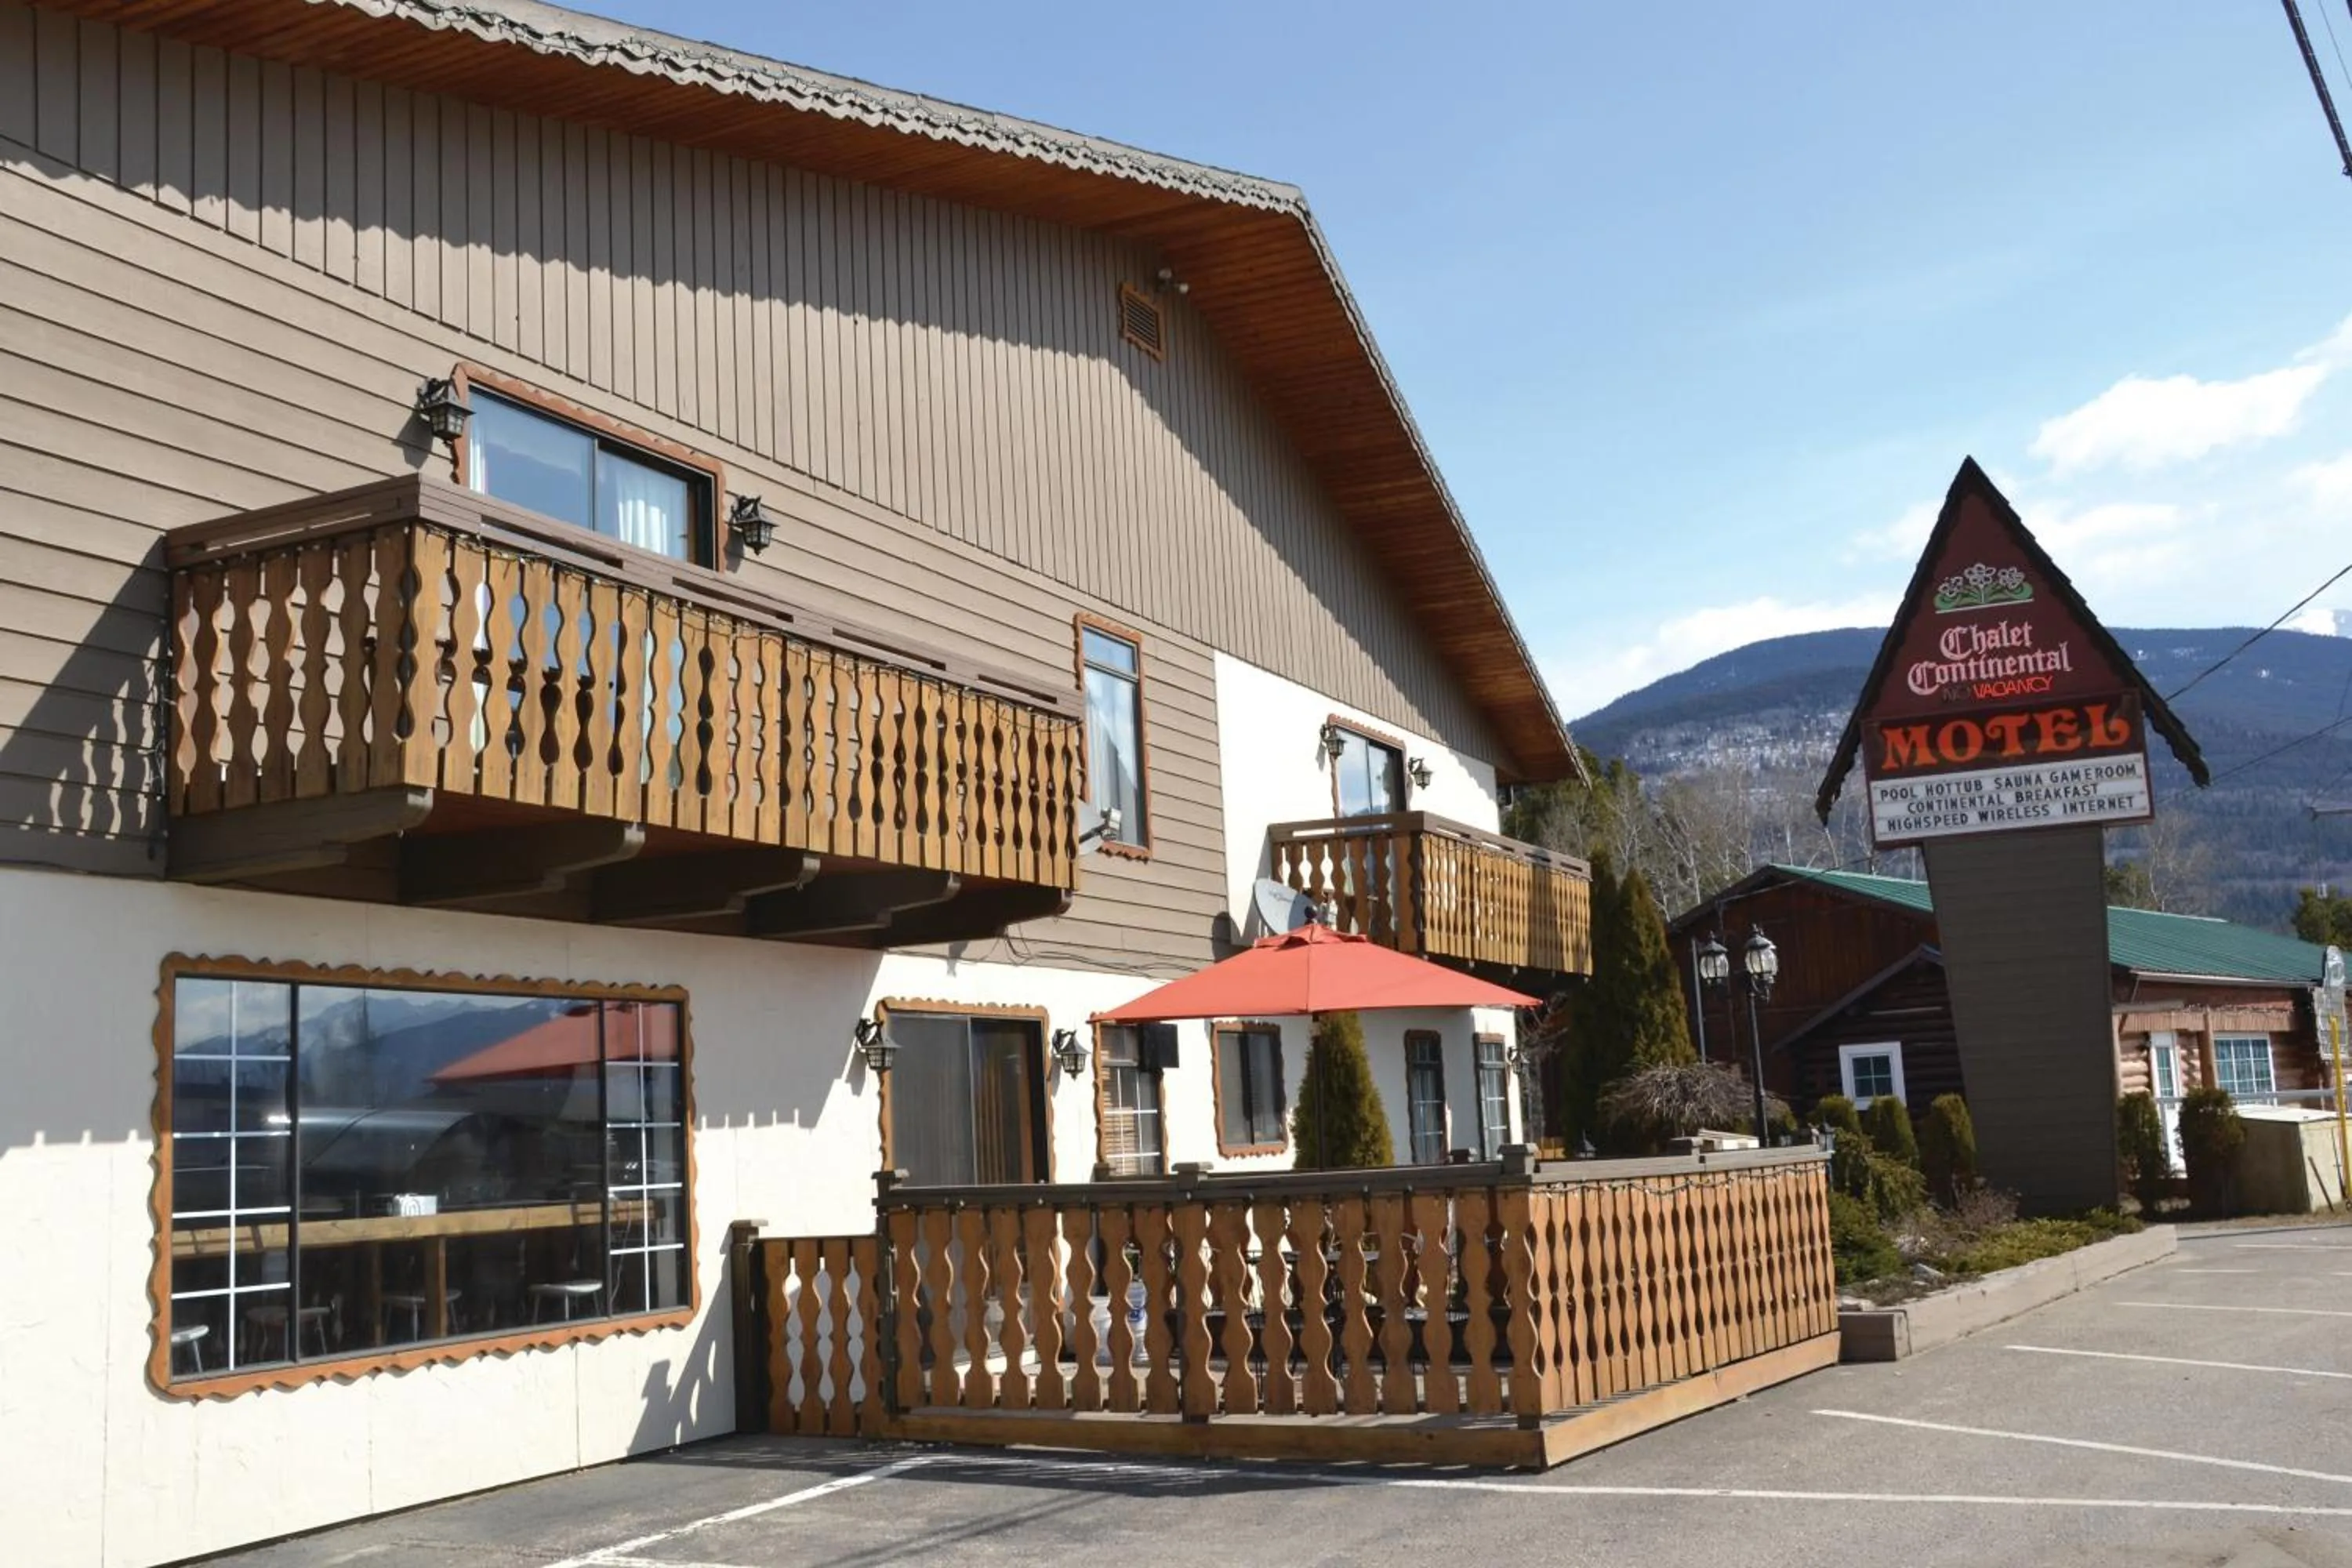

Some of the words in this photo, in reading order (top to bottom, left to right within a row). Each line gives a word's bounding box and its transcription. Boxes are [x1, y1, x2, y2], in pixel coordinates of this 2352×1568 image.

[1940, 620, 2032, 660] Chalet
[1907, 641, 2073, 695] Continental
[1973, 676, 2053, 699] VACANCY
[1882, 704, 2131, 770] MOTEL
[1881, 786, 1918, 801] POOL
[1994, 773, 2043, 790] SAUNA
[1907, 794, 2005, 815] CONTINENTAL
[2016, 783, 2099, 804] BREAKFAST
[1888, 813, 1969, 832] HIGHSPEED
[1978, 804, 2050, 822] WIRELESS
[2063, 795, 2133, 815] INTERNET
